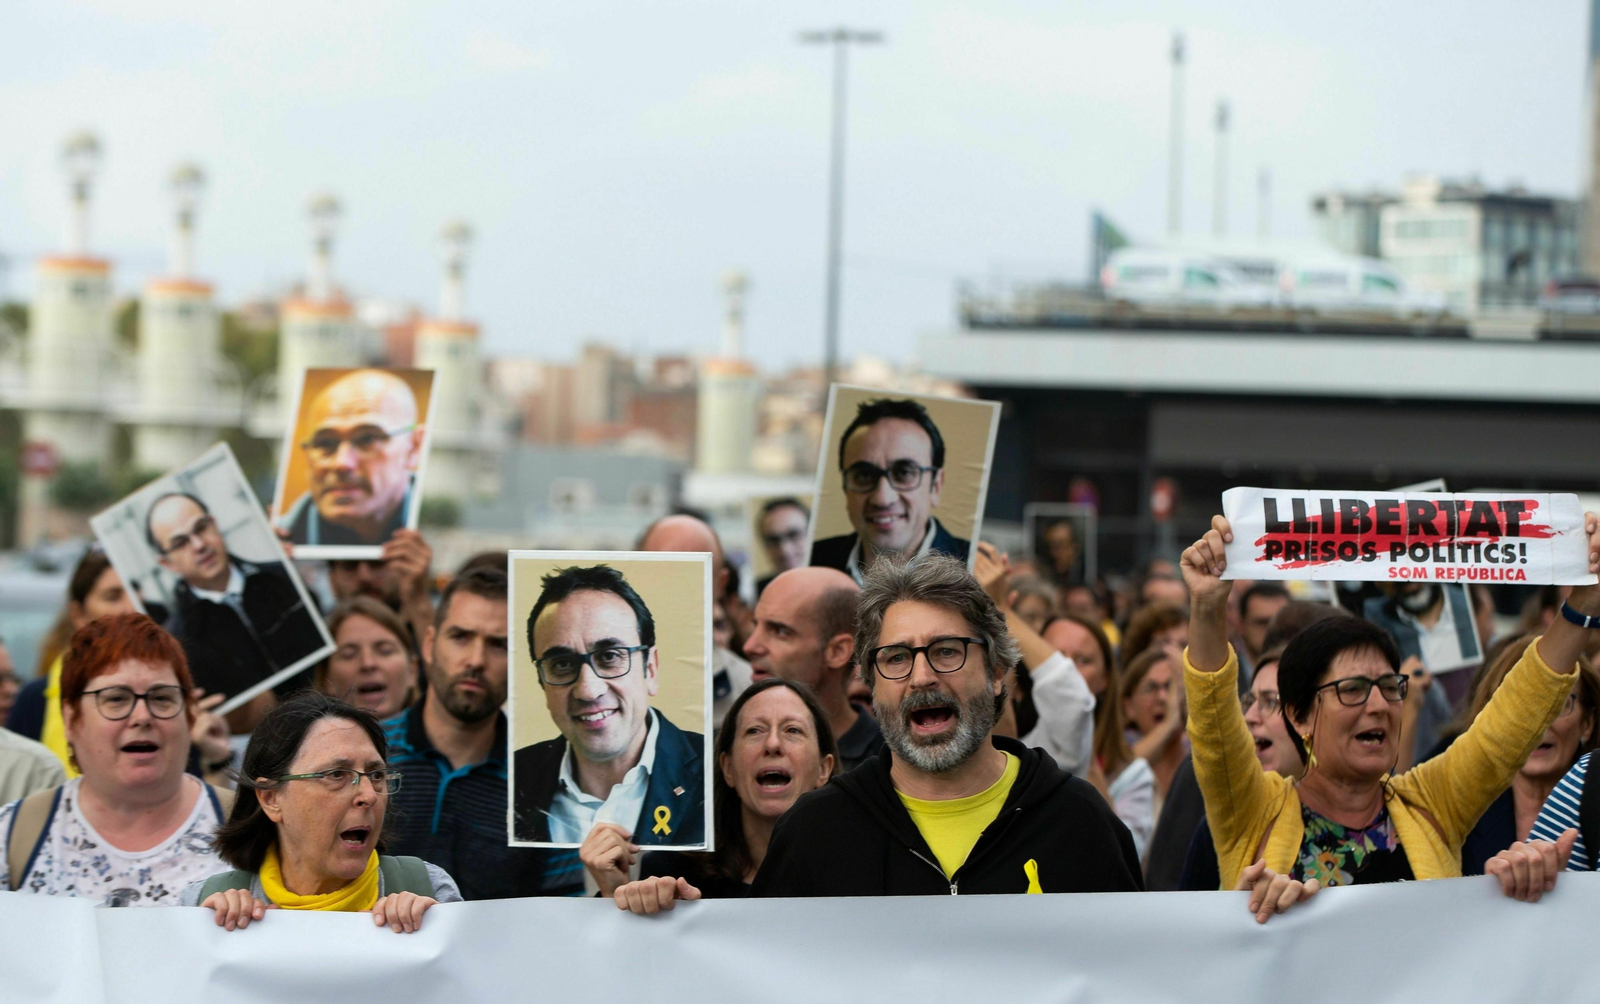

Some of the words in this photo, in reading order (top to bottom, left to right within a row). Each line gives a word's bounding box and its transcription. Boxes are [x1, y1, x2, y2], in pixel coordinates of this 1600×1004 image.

[1263, 497, 1525, 537] LLIBERTAT
[1265, 540, 1377, 562] PRESOS
[1390, 537, 1528, 564] POLÍTICS!
[1388, 566, 1428, 579] SOM
[1435, 564, 1527, 581] REPÚBLICA
